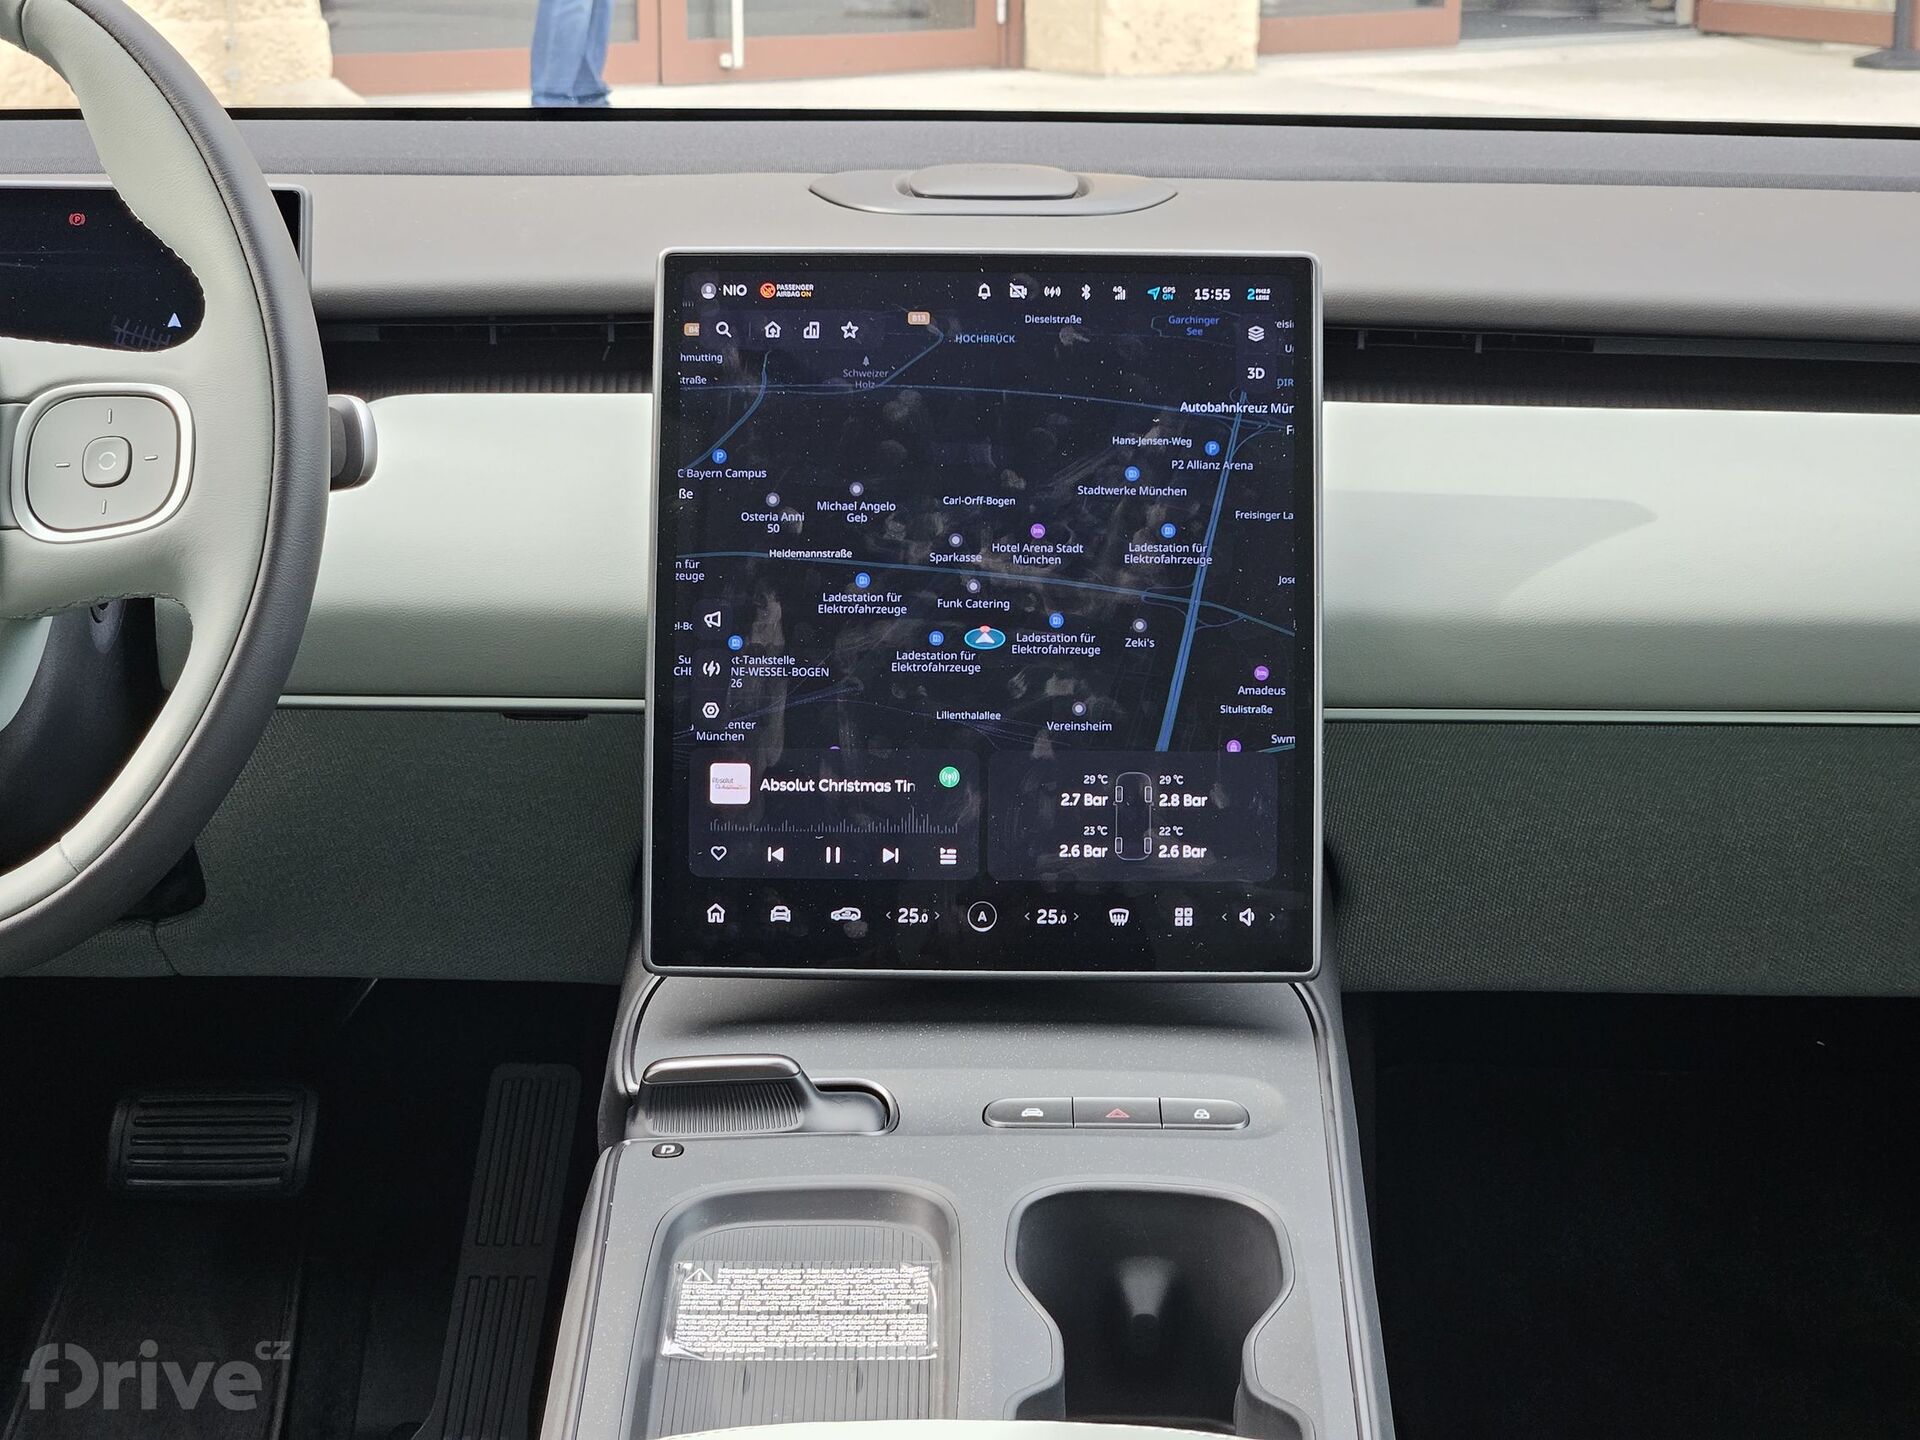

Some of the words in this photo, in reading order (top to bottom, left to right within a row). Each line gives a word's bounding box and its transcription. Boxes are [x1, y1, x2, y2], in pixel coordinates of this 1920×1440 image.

[723, 284, 748, 297] NIO
[1194, 288, 1231, 301] 15:55
[1247, 288, 1256, 301] 2
[1024, 314, 1082, 324] Dieselstraße
[1168, 315, 1220, 326] Garchinger
[1186, 327, 1203, 336] See
[955, 334, 1016, 344] HOCHBRÜCK
[680, 353, 723, 364] hmutting
[843, 368, 889, 379] Schweizer
[1247, 367, 1266, 380] 3D
[855, 379, 875, 388] Holz
[1180, 402, 1268, 414] Autobahnkreuz
[1112, 436, 1192, 448] Hans-Jensen-Weg
[1171, 460, 1184, 470] P2
[1186, 460, 1221, 470] Allianz
[1222, 461, 1254, 471] Arena
[686, 468, 722, 480] Bayern
[725, 468, 767, 480] Campus
[1077, 485, 1137, 496] Stadtwerke
[1139, 486, 1187, 496] München
[817, 501, 858, 511] Michael
[860, 501, 896, 512] Angelo
[943, 496, 1016, 506] Carl-Orff-Bogen
[740, 512, 778, 522] Osteria
[780, 512, 805, 522] Anni
[846, 513, 868, 523] Geb
[1235, 510, 1281, 522] Freisinger
[767, 524, 780, 534] 50
[769, 549, 852, 558] Heidemannstraße
[992, 542, 1020, 552] Hotel
[1022, 543, 1054, 553] Arena
[1056, 543, 1084, 554] Stadt
[1129, 543, 1190, 553] Ladestation
[1192, 543, 1208, 553] für
[929, 552, 982, 564] Sparkasse
[1012, 554, 1062, 564] München
[1124, 554, 1212, 566] Elektrofahrzeuge
[684, 560, 700, 568] für
[676, 573, 704, 582] zeuge
[822, 592, 884, 602] Ladestation
[886, 592, 902, 602] für
[937, 598, 962, 608] Funk
[965, 599, 1010, 610] Catering
[818, 604, 907, 616] Elektrofahrzeuge
[1016, 633, 1077, 643] Ladestation
[1080, 633, 1096, 643] für
[1124, 638, 1155, 648] Zeki's
[1012, 644, 1101, 656] Elektrofahrzeuge
[896, 651, 957, 661] Ladestation
[960, 651, 976, 661] für
[730, 667, 830, 677] NE-WESSEL-BOGEN
[891, 662, 981, 674] Elektrofahrzeuge
[730, 678, 743, 688] 26
[1238, 686, 1286, 696] Amadeus
[1220, 704, 1273, 714] Situlistraße
[936, 710, 1001, 720] Lilienthalallee
[725, 722, 756, 730] enter
[1046, 722, 1112, 732] Vereinsheim
[696, 732, 745, 742] München
[760, 778, 816, 792] Absolut
[818, 778, 892, 792] Christmas
[1060, 793, 1081, 806] 2.7
[1084, 793, 1109, 806] Bar
[1158, 794, 1180, 807] 2.8
[1183, 794, 1208, 807] Bar
[1083, 826, 1096, 836] 23
[1158, 826, 1171, 836] 22
[1059, 844, 1080, 858] 2.6
[1083, 844, 1108, 858] Bar
[1158, 844, 1180, 858] 2.6
[1182, 844, 1208, 858] Bar
[898, 908, 928, 924] 25.0
[978, 911, 987, 922] A
[1036, 908, 1067, 925] 25.0
